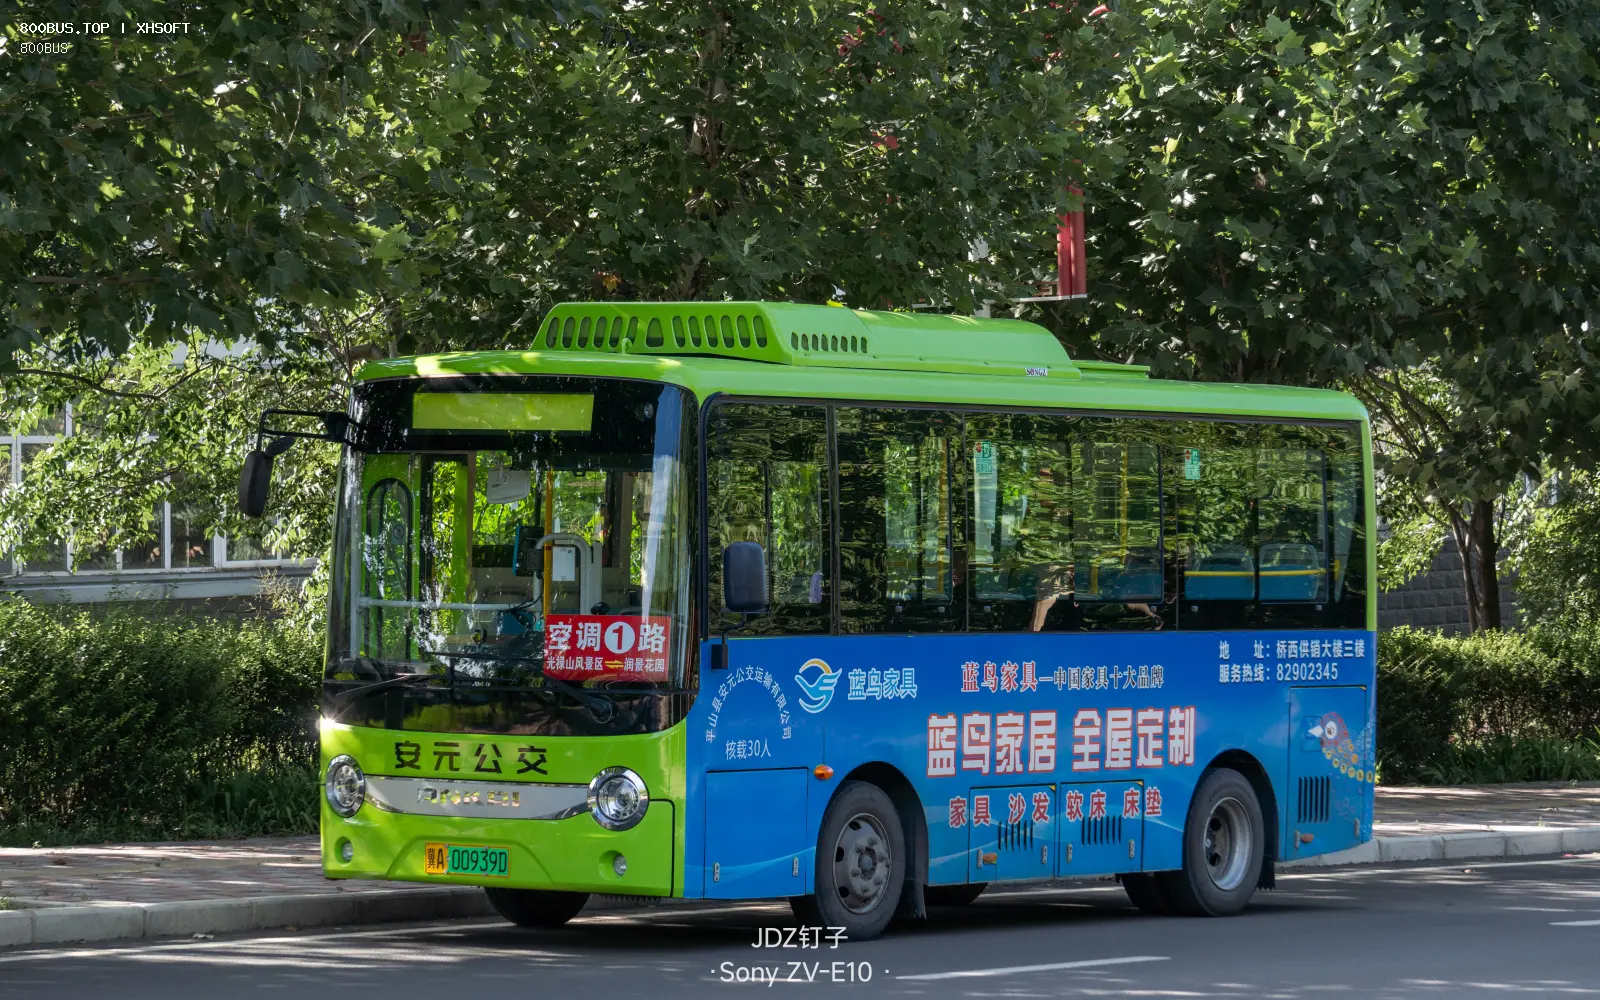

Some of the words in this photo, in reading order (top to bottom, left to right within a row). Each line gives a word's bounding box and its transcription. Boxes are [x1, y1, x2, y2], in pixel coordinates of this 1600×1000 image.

[623, 657, 665, 673] 润景花园
[848, 667, 918, 700] 蓝鸟家具
[705, 665, 792, 743] 平山县安元公交运输有限公司
[394, 740, 548, 775] 安元公交
[725, 738, 771, 760] 核载30人
[926, 709, 1057, 778] 蓝鸟家居
[1072, 705, 1196, 772] 全屋定制
[949, 795, 991, 829] 家具
[1007, 791, 1050, 825] 沙发
[1066, 788, 1107, 821] 软床
[1122, 786, 1163, 817] 床垫
